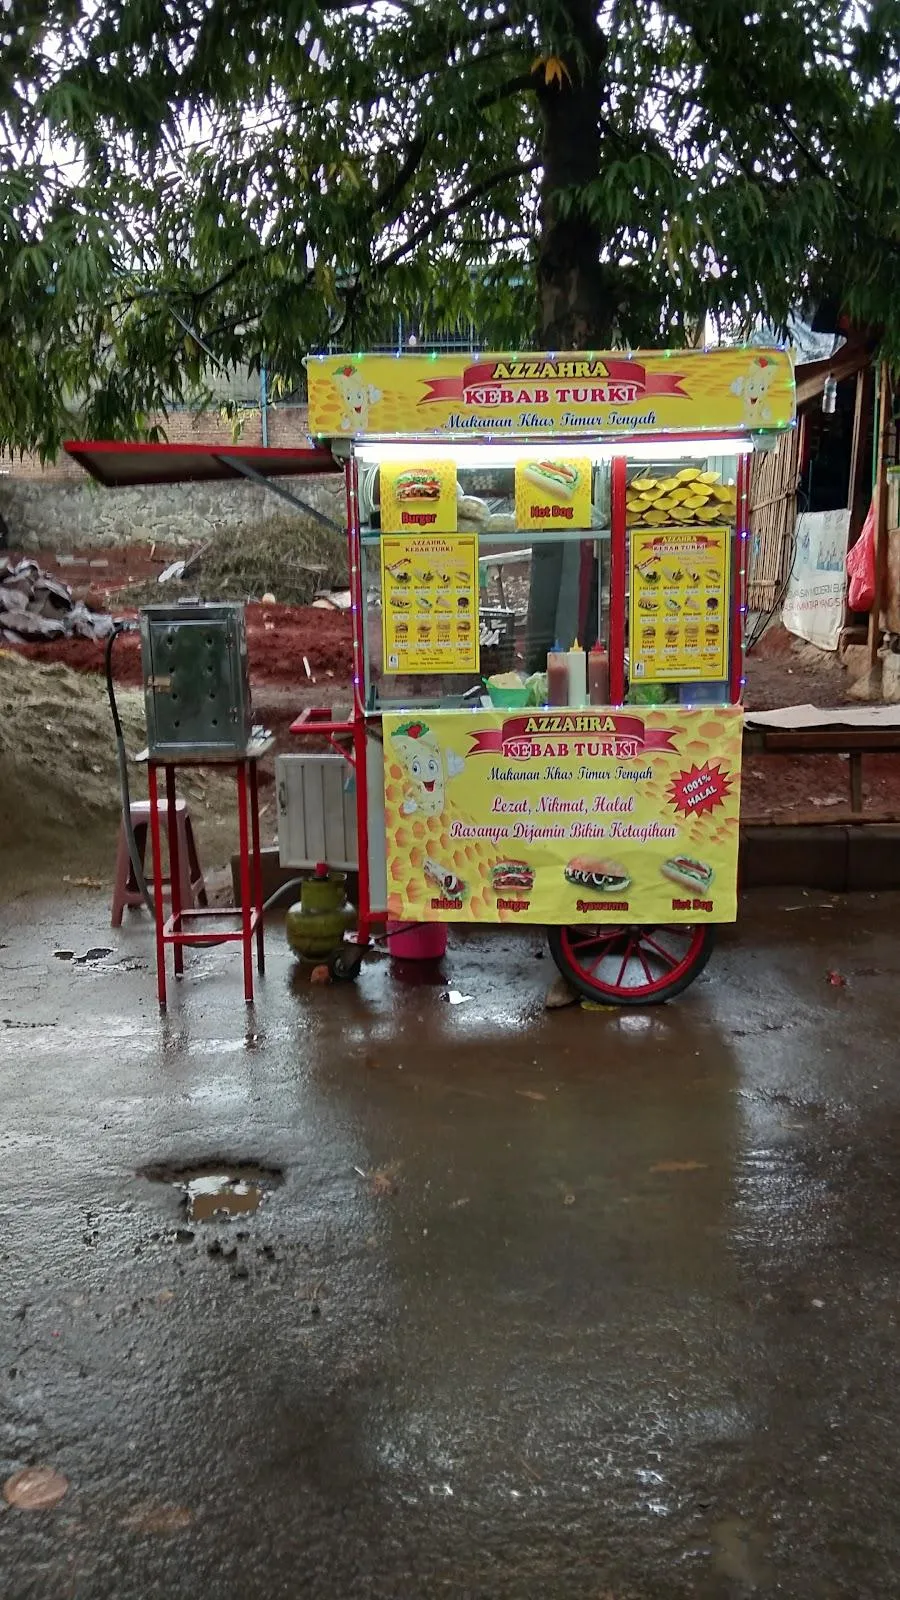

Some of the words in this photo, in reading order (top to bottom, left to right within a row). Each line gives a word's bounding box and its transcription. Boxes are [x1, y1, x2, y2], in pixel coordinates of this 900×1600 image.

[492, 361, 610, 379] AZZAHRA
[464, 389, 550, 405] KEBAB
[556, 387, 637, 403] TURKI
[445, 415, 512, 429] Makanan
[517, 413, 554, 427] Khas
[560, 412, 602, 426] Timur
[607, 411, 656, 429] Tengah
[402, 512, 437, 526] Burger
[530, 506, 550, 518] Hot
[551, 505, 574, 519] Dog
[524, 716, 617, 732] AZZAHRA
[502, 743, 569, 757] KEBAB
[574, 741, 638, 756] TURKI
[487, 767, 540, 781] Makanan
[544, 766, 573, 780] Khas
[577, 766, 610, 780] Timur
[614, 766, 652, 783] Tengah
[687, 785, 718, 807] HALAL
[491, 796, 532, 815] Lezat,
[535, 796, 588, 814] Nikmat,
[592, 796, 634, 812] Halal
[450, 822, 509, 842] Rasanya
[513, 822, 565, 843] Dijamin
[569, 822, 604, 838] Bikin
[608, 822, 676, 843] Ketagihan
[431, 897, 462, 909] Kebab
[496, 898, 531, 912] Burger
[671, 898, 691, 910] Hot
[692, 898, 713, 912] Dog
